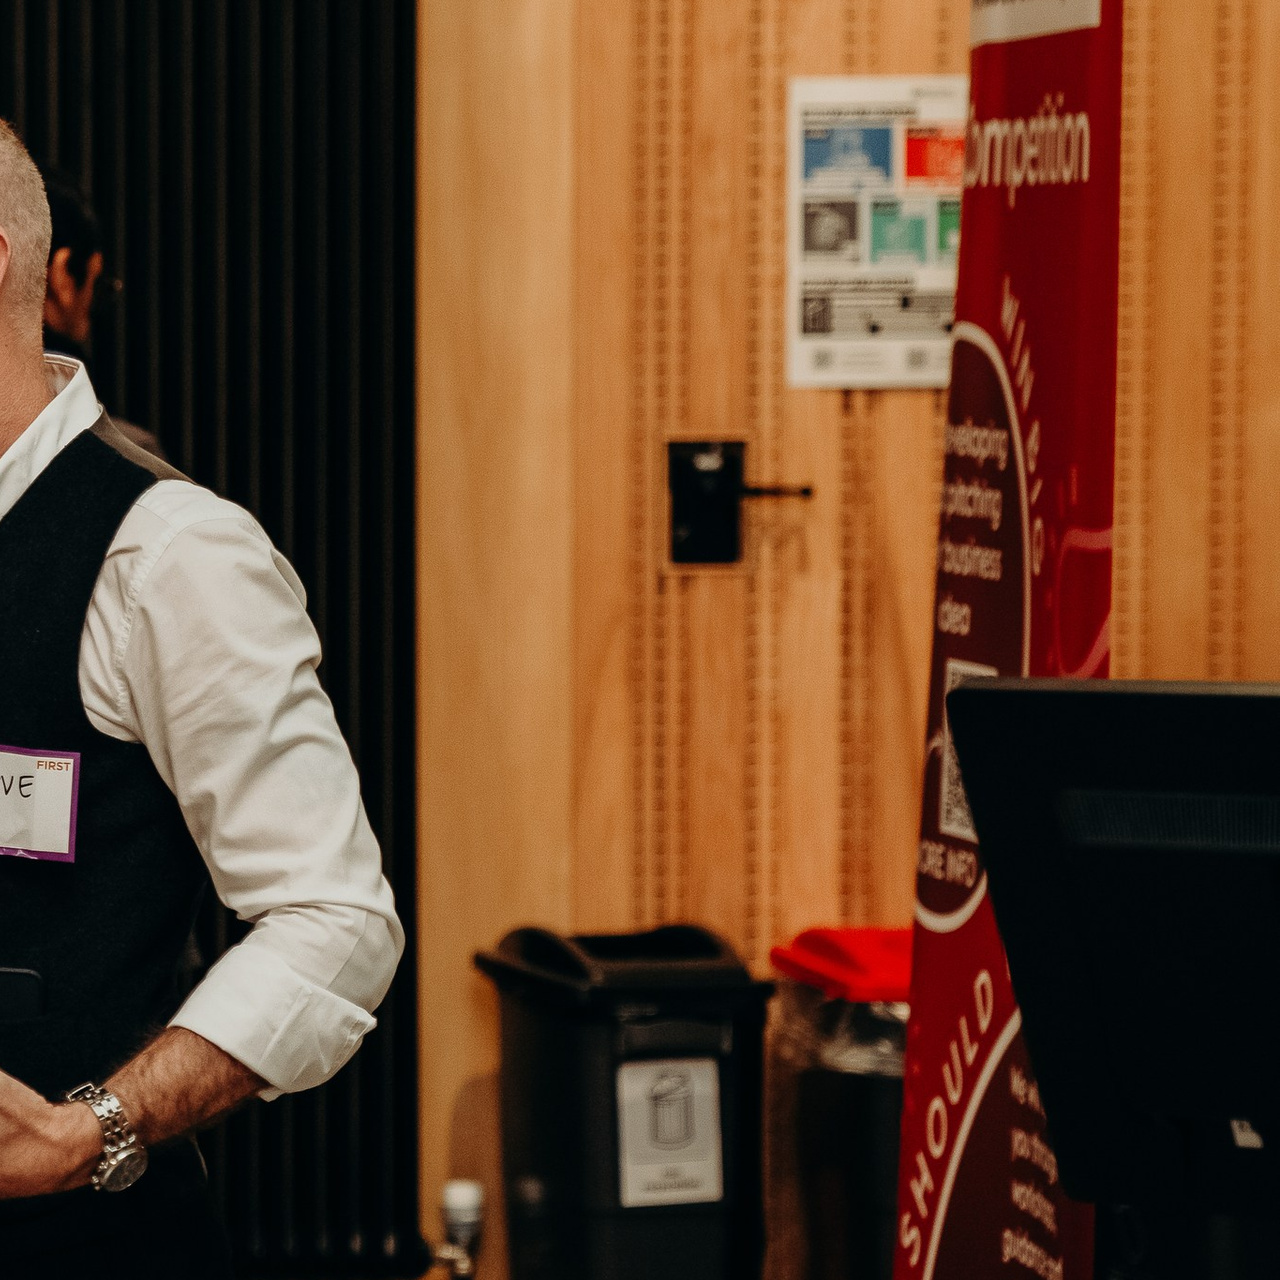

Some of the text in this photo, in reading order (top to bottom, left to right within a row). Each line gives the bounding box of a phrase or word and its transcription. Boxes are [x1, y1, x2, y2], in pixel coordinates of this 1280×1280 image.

[964, 93, 1090, 209] ompetition
[36, 760, 71, 772] FIRST
[900, 969, 994, 1267] SHOULD
